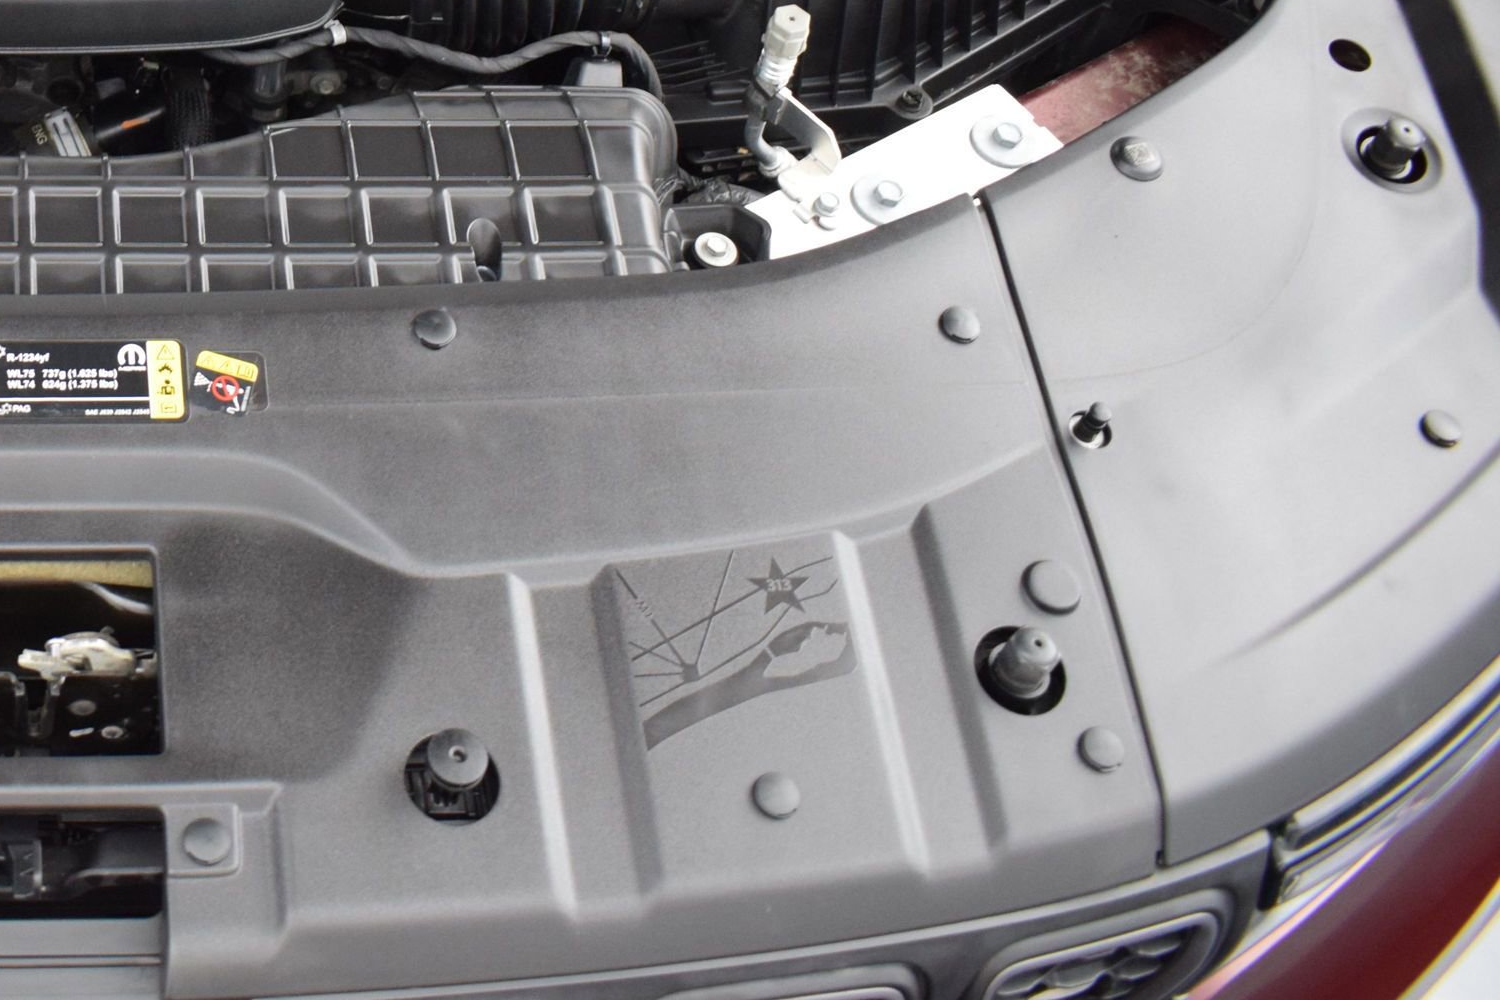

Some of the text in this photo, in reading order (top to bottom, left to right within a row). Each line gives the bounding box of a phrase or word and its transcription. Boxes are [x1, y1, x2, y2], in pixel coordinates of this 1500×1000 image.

[31, 123, 48, 145] ENG
[6, 352, 50, 364] R-1234yf
[6, 368, 35, 379] WL75
[41, 368, 66, 380] 737g
[67, 368, 98, 380] (1.625
[98, 368, 118, 380] lbs)
[6, 379, 119, 391] WL74 624g (1.375 lbs)
[12, 403, 32, 414] PAG
[766, 578, 793, 593] 313
